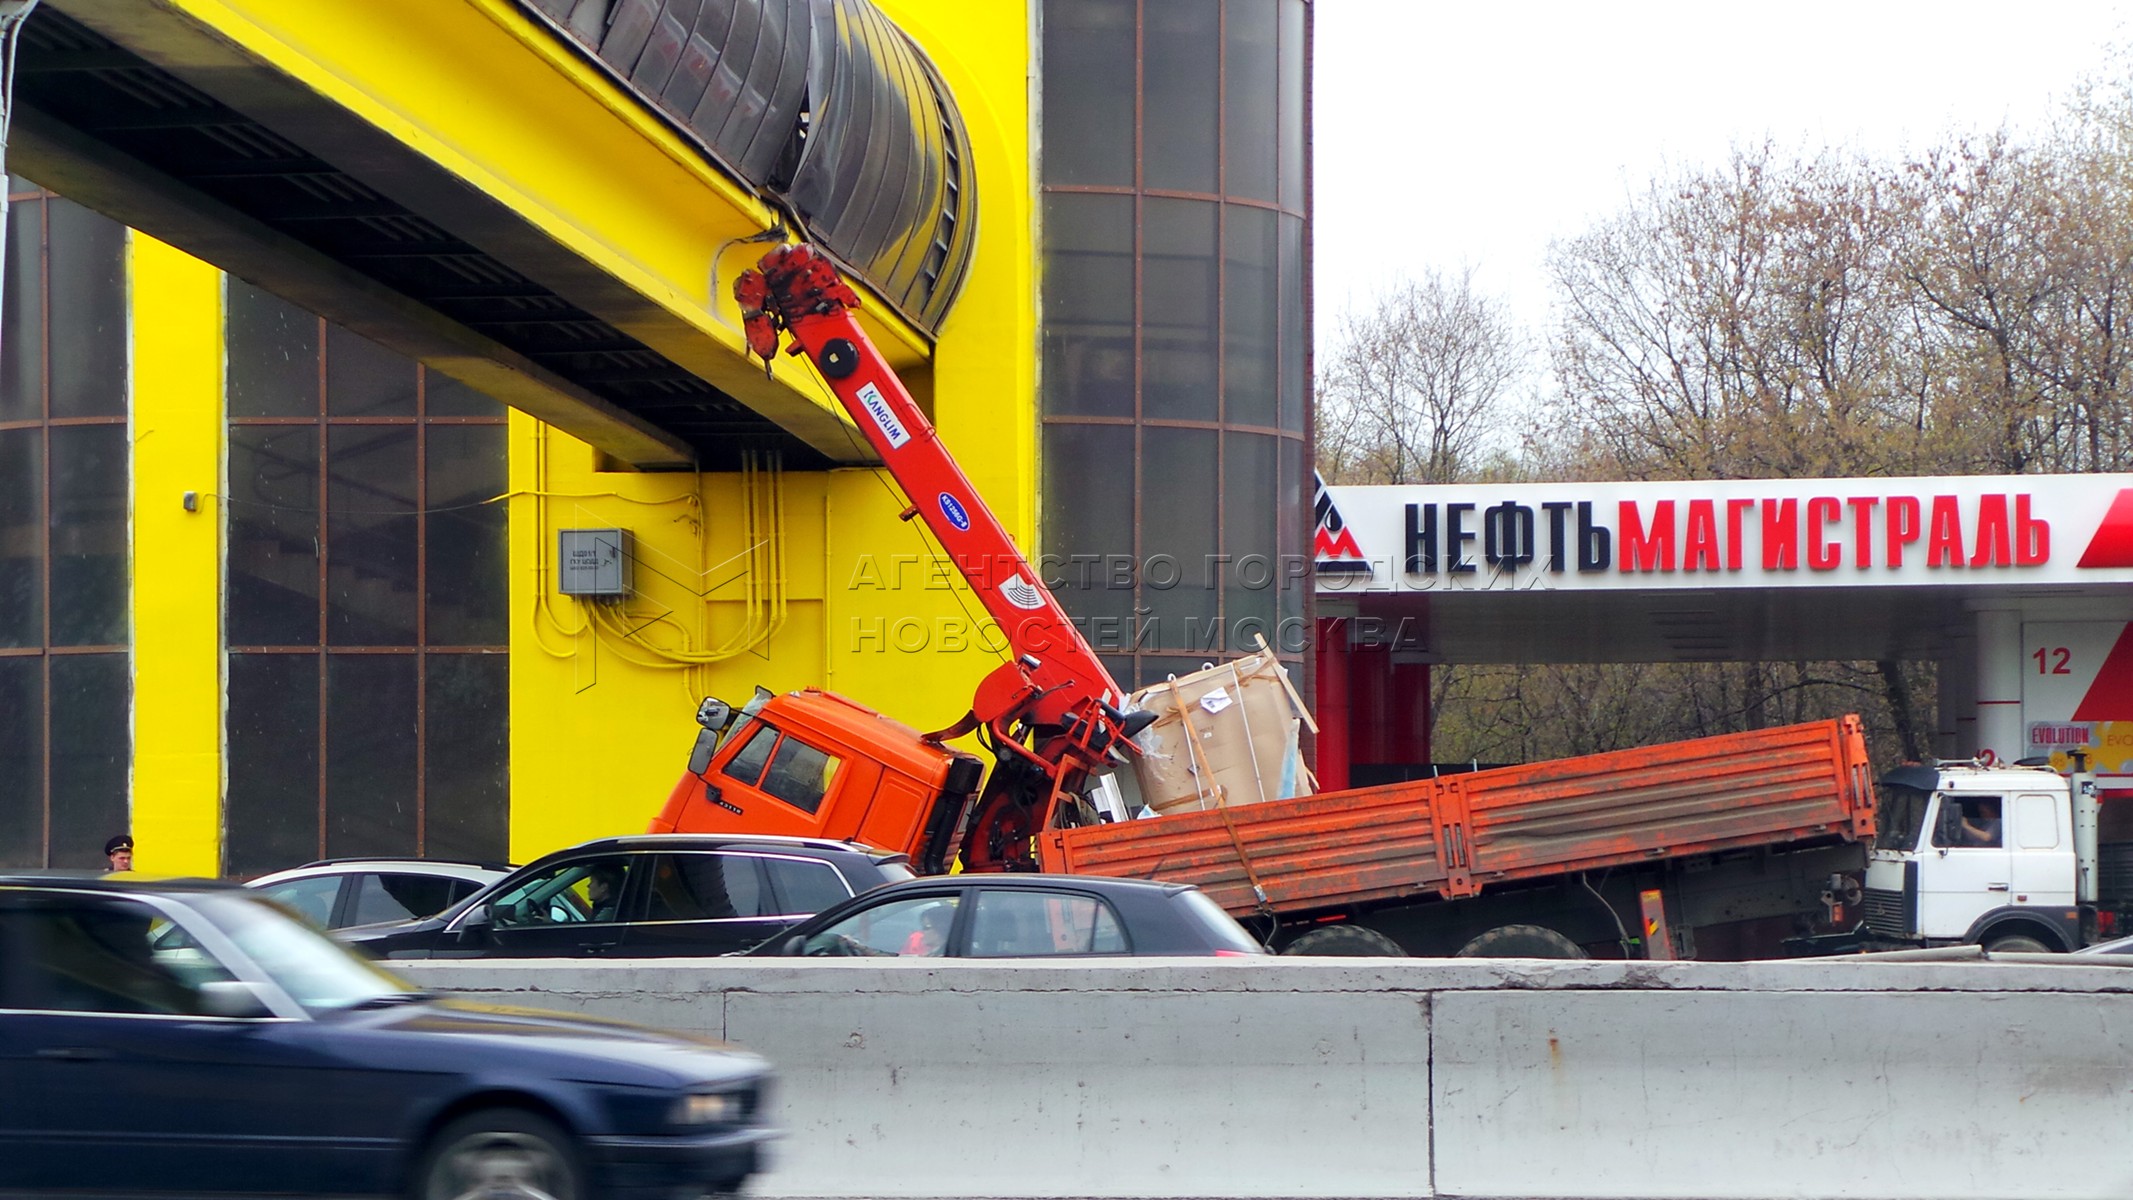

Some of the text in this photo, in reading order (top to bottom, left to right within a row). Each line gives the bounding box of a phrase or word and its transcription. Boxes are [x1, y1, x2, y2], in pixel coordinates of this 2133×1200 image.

[863, 389, 901, 440] KANGLIM
[1405, 494, 2051, 574] НЕФТЬМАГИСТРАЛЬ
[2032, 647, 2071, 675] 12
[2032, 727, 2089, 744] EVOLUTION
